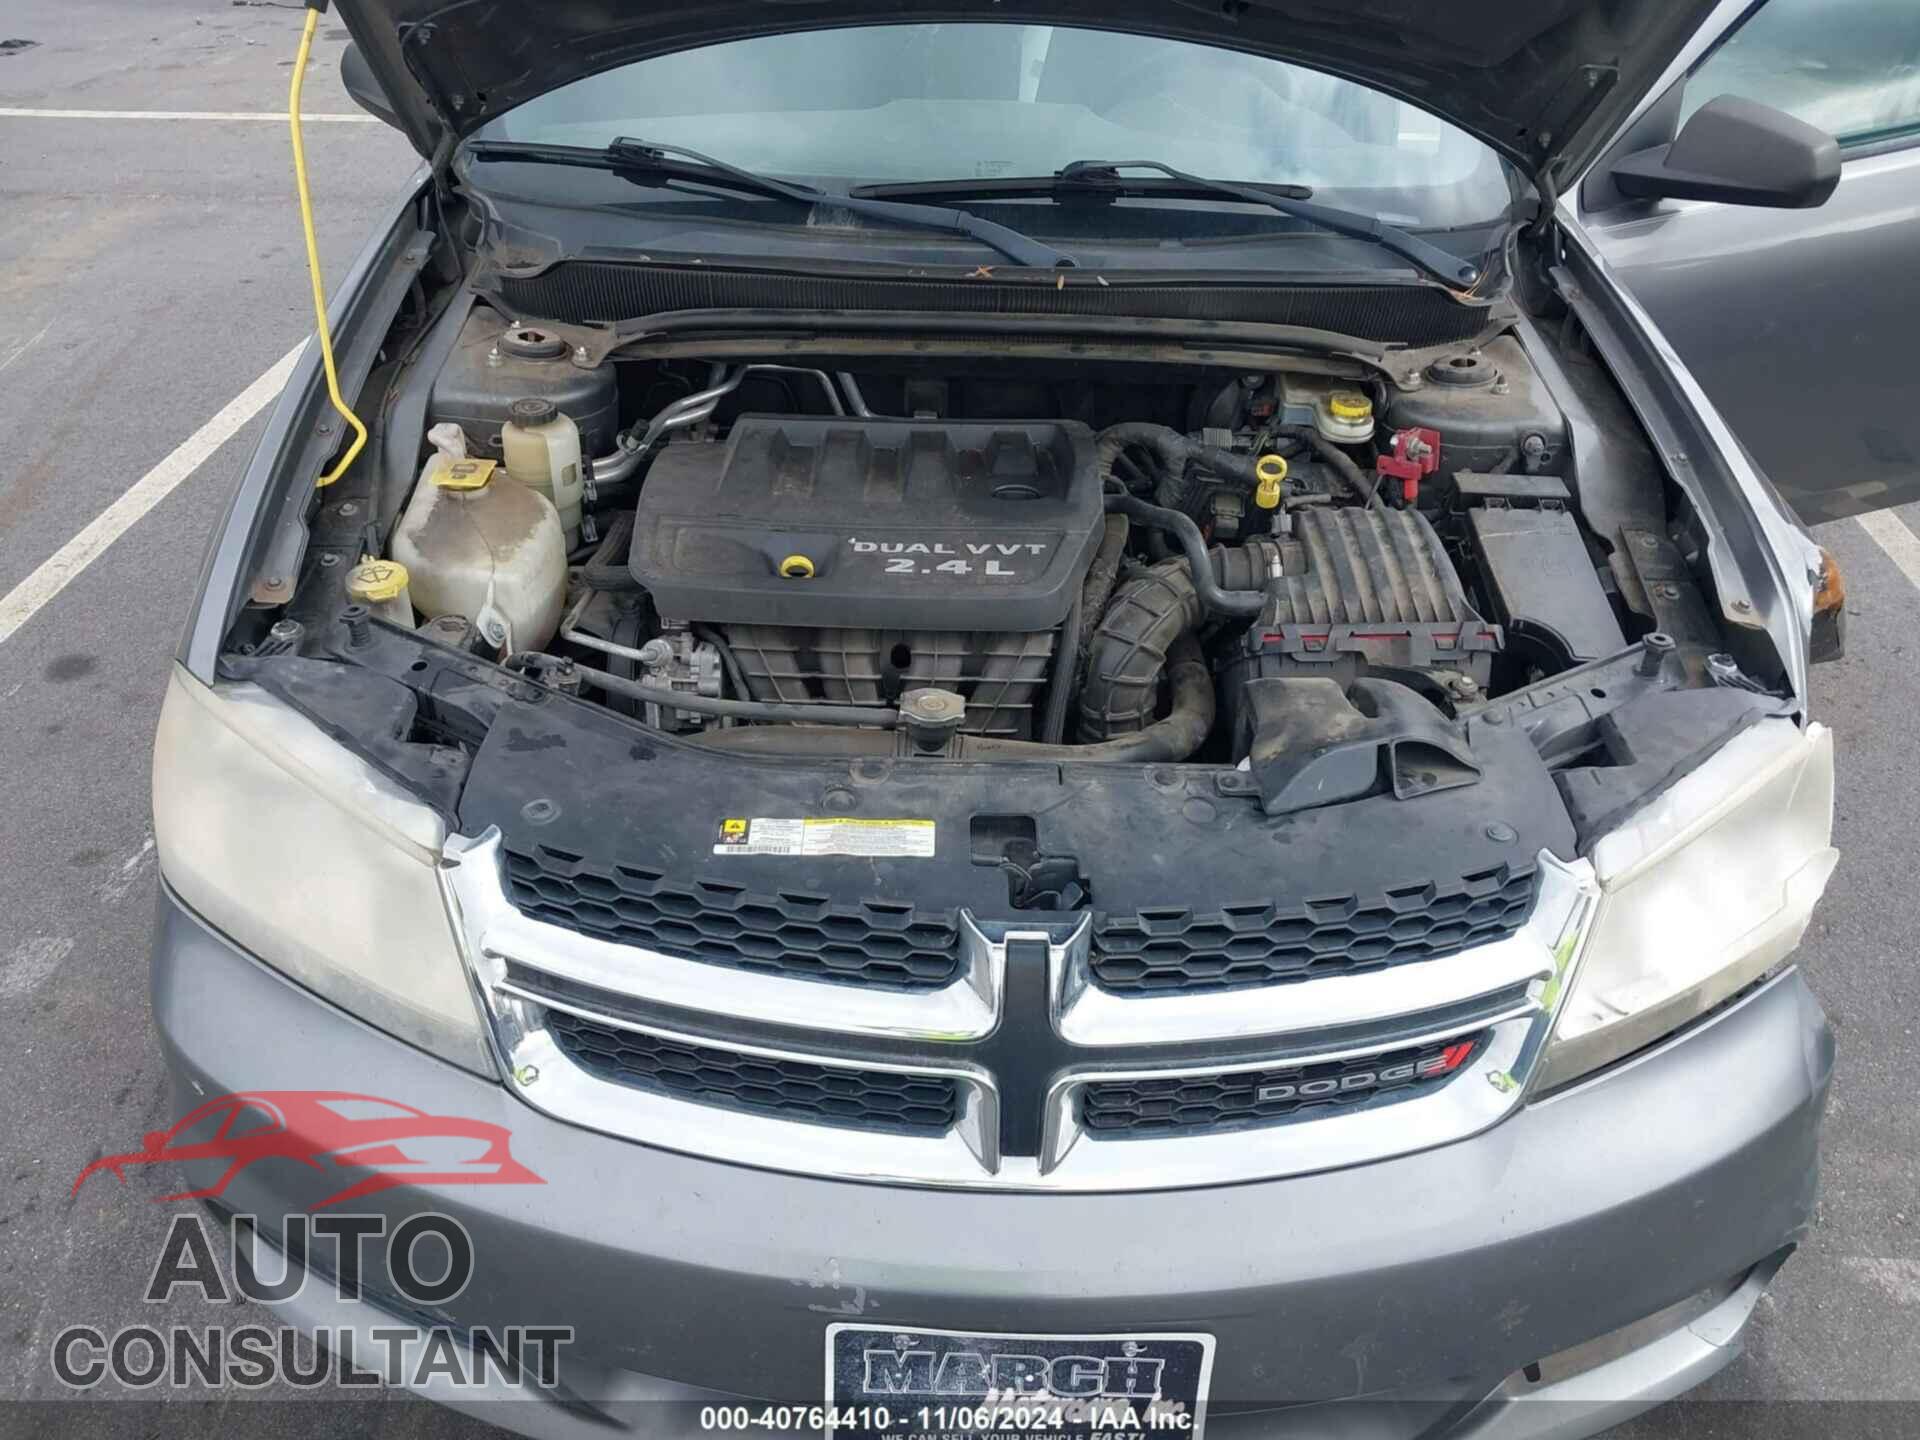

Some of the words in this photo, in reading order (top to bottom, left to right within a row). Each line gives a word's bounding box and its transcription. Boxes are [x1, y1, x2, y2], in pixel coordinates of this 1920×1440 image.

[853, 542, 956, 554] DUAL
[966, 543, 1046, 555] VVT
[1258, 1058, 1447, 1101] DODGE
[863, 1349, 1166, 1397] MARCH
